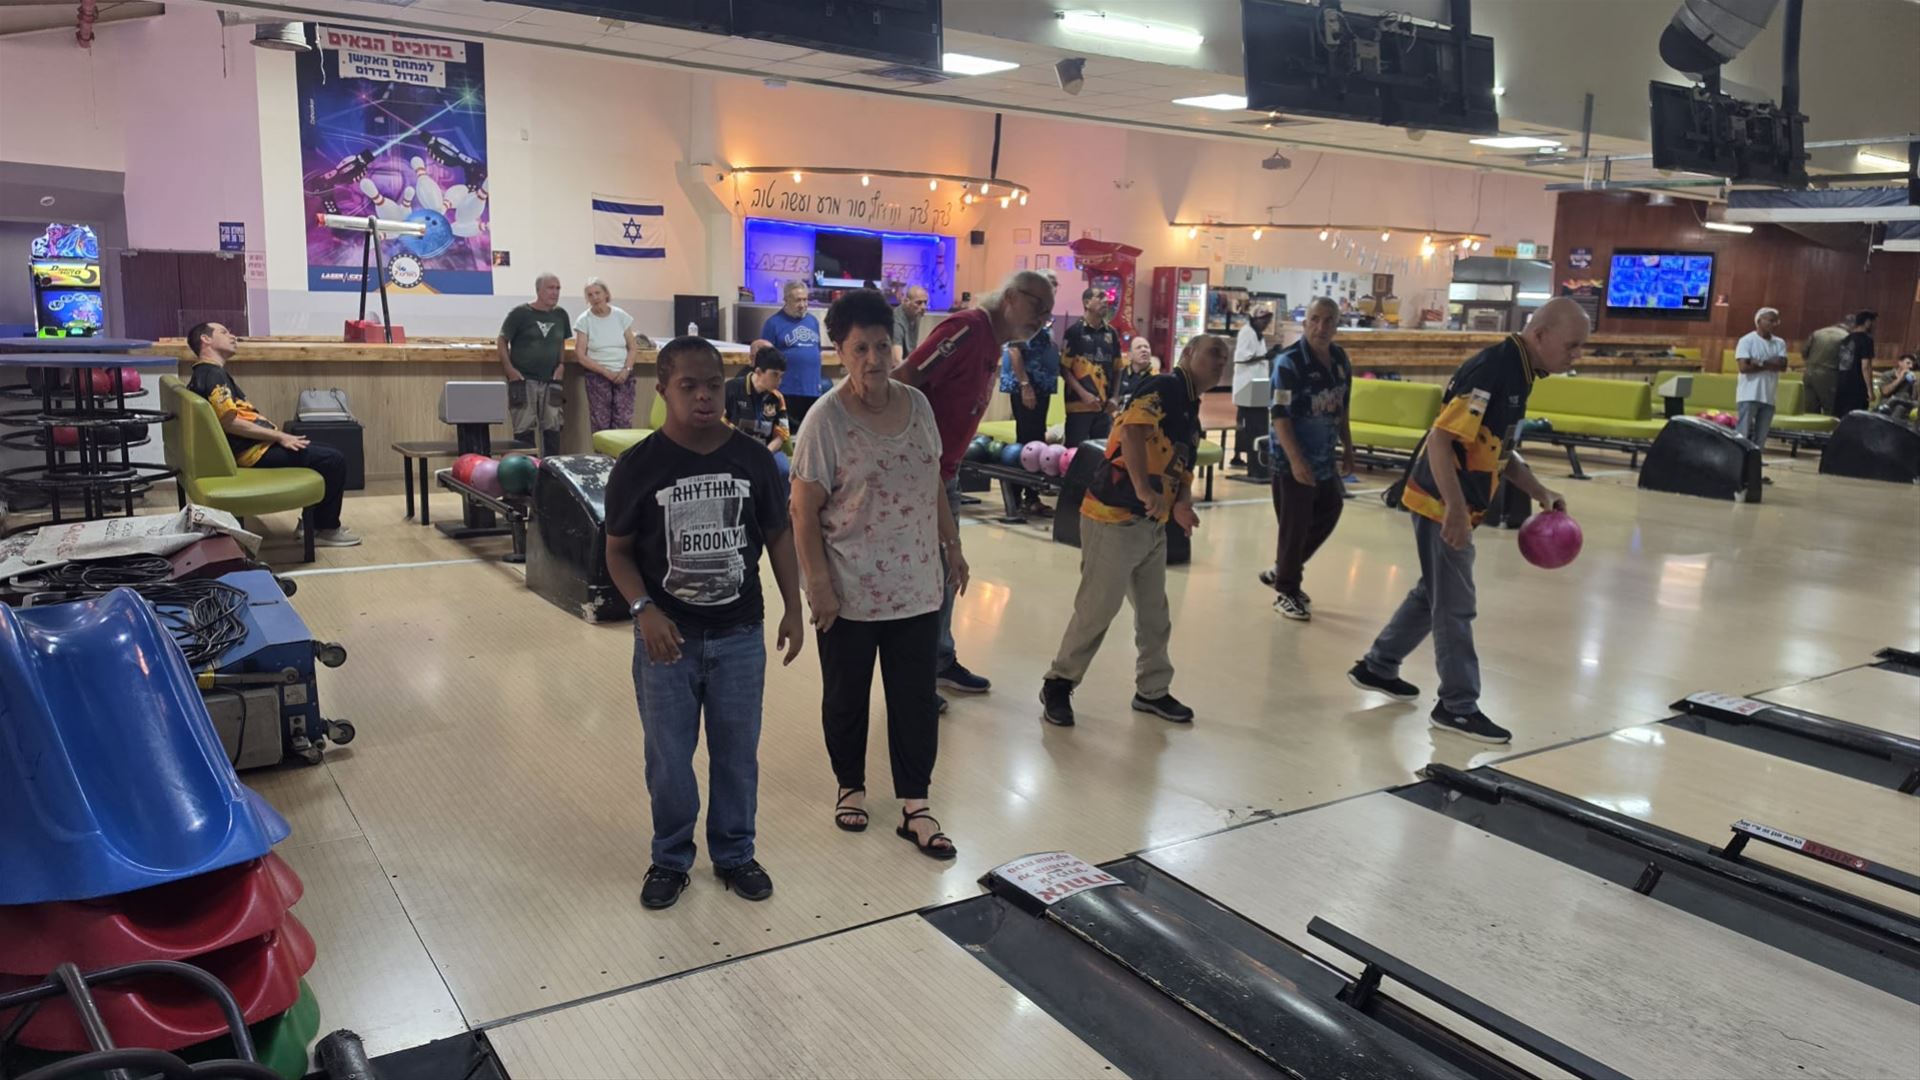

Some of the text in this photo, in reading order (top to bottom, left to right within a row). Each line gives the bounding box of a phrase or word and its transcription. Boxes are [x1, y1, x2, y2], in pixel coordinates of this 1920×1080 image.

[327, 31, 454, 59] ברוכים הבאים
[347, 52, 435, 73] למתחם האקשן
[355, 65, 428, 83] הגדול בדרום
[751, 179, 776, 209] טוב
[780, 191, 811, 213] ועשה
[817, 196, 841, 216] מרע
[847, 199, 866, 218] סור
[747, 252, 811, 274] LASER
[672, 480, 736, 502] RHYTHM
[682, 528, 747, 552] BROOKLYN
